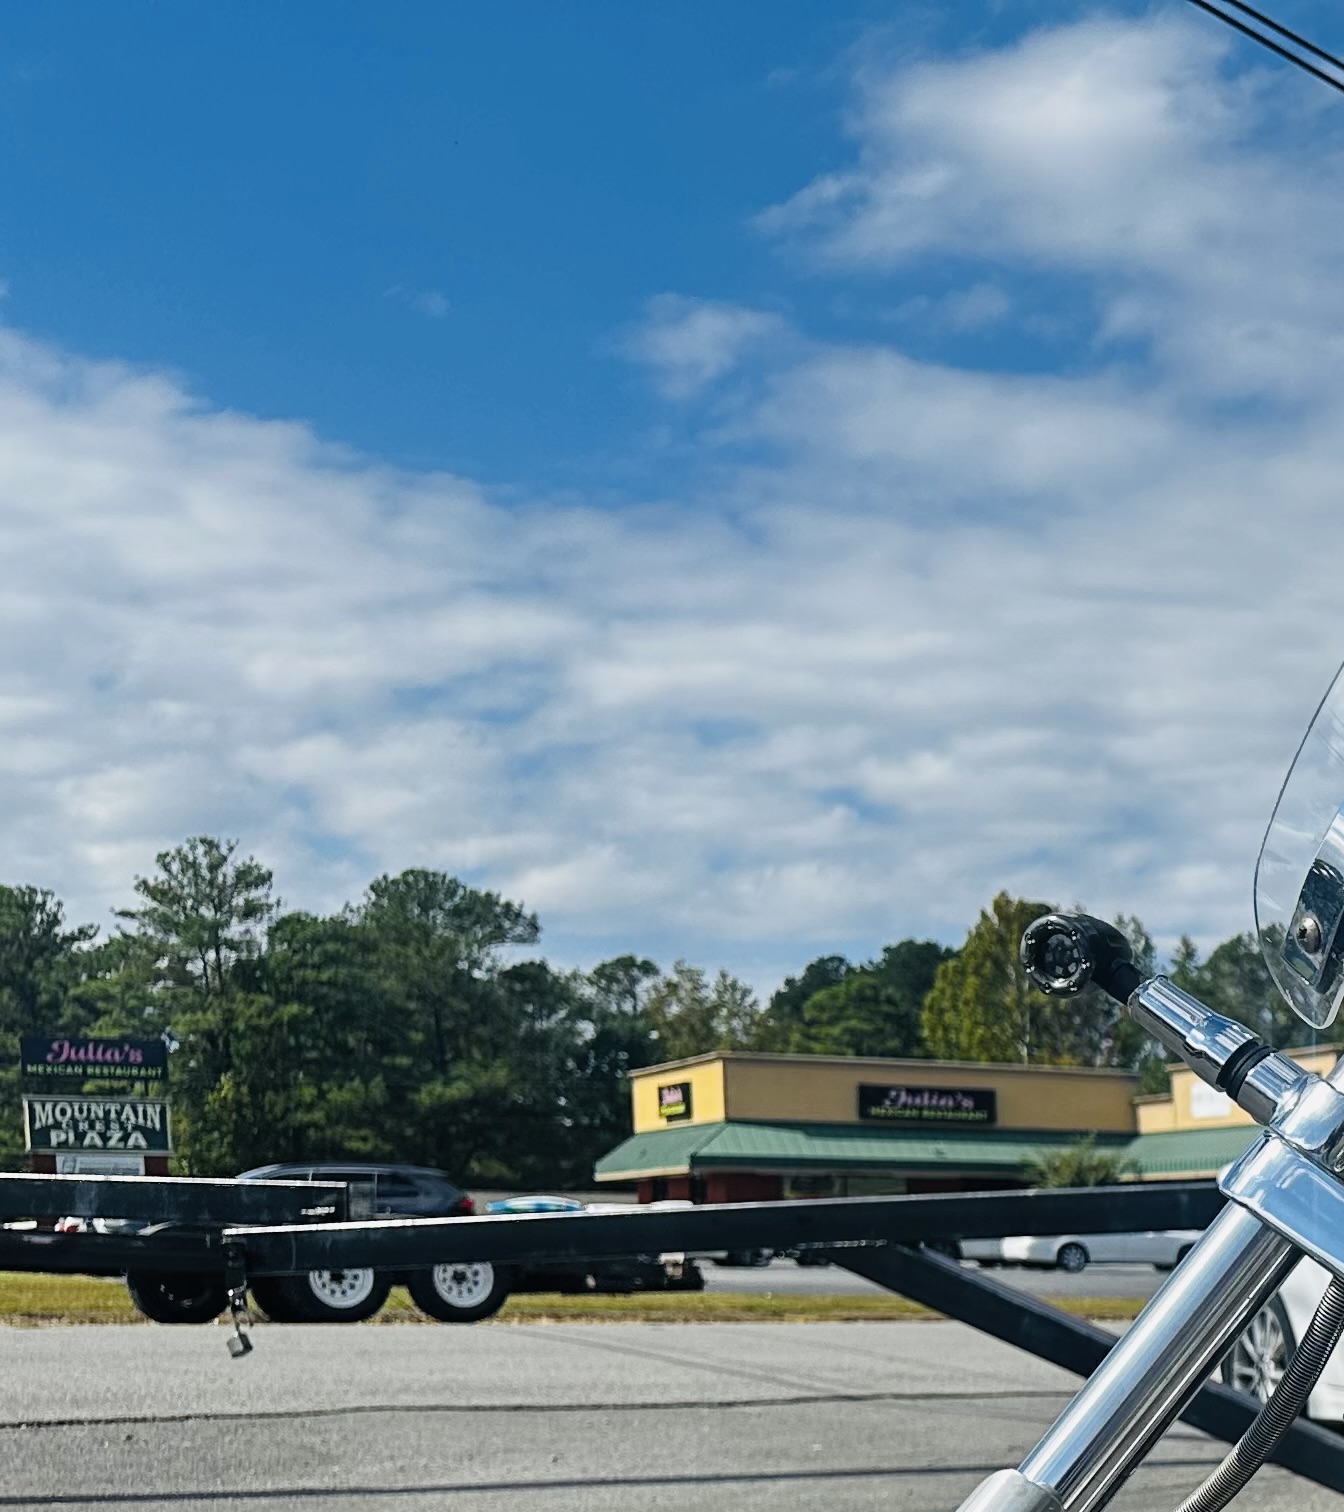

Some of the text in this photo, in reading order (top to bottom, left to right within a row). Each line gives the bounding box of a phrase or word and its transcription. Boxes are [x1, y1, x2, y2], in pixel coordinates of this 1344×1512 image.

[46, 1039, 144, 1064] Julia's
[27, 1063, 162, 1078] MEXICAN RESTAURANT
[884, 1087, 975, 1109] Julia's
[33, 1101, 162, 1131] MOUNTAIN
[61, 1119, 134, 1133] CREST
[50, 1129, 148, 1149] PLAZA
